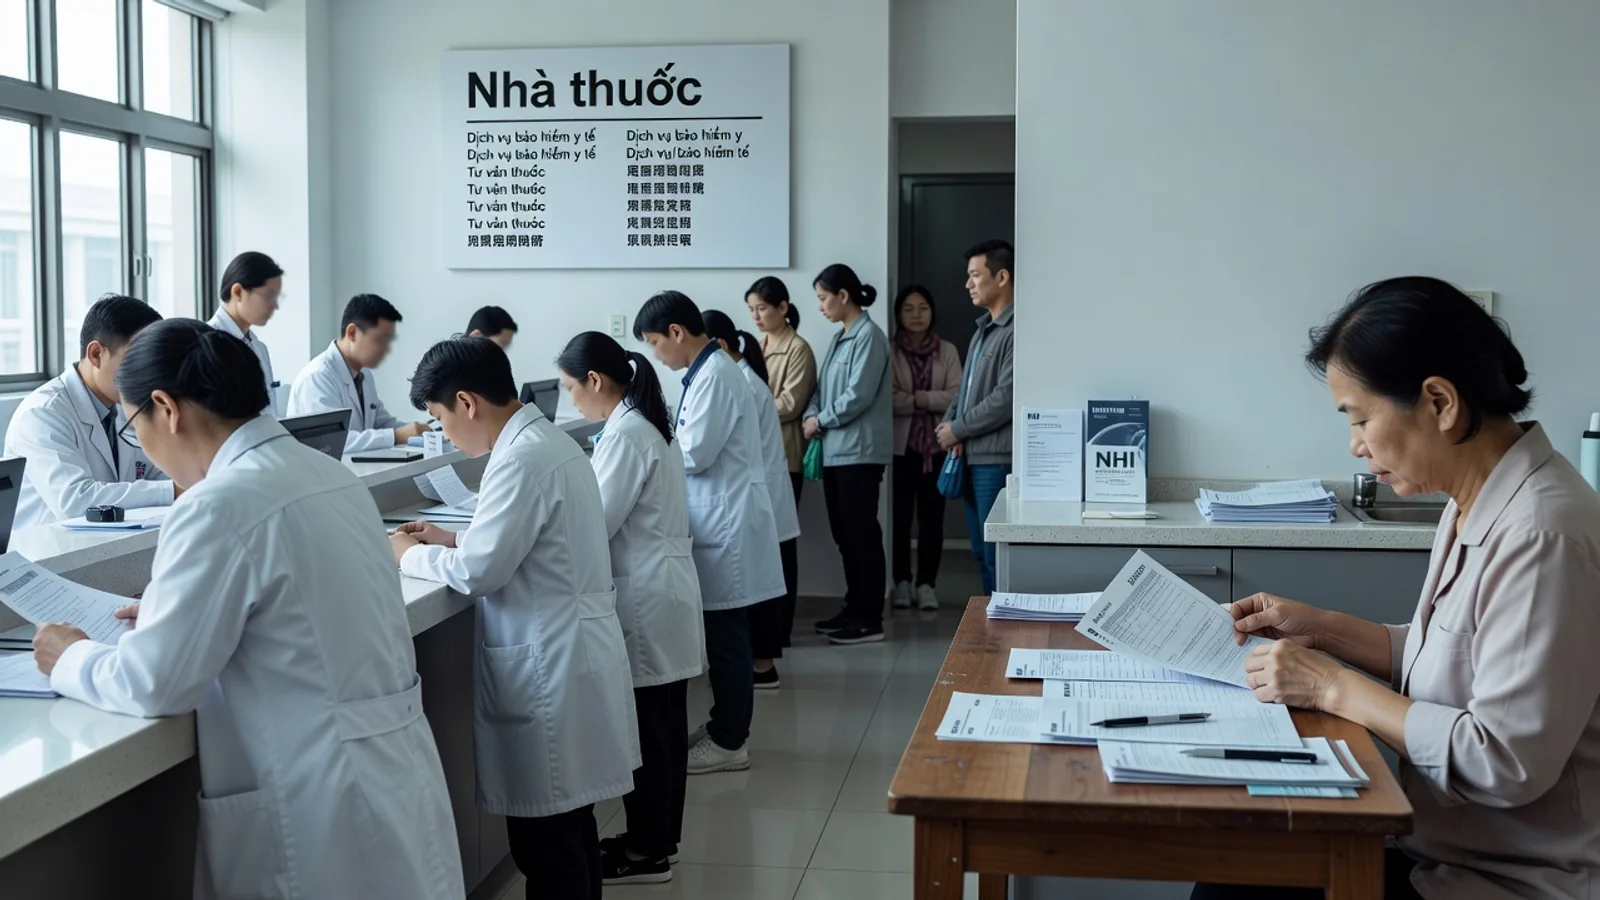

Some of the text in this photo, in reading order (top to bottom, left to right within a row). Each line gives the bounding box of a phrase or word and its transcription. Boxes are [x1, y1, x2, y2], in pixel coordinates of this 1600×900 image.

[468, 63, 702, 108] Nhà thuốc
[574, 134, 581, 145] y
[735, 132, 742, 143] y
[574, 152, 581, 162] y
[1096, 451, 1134, 468] NHI
